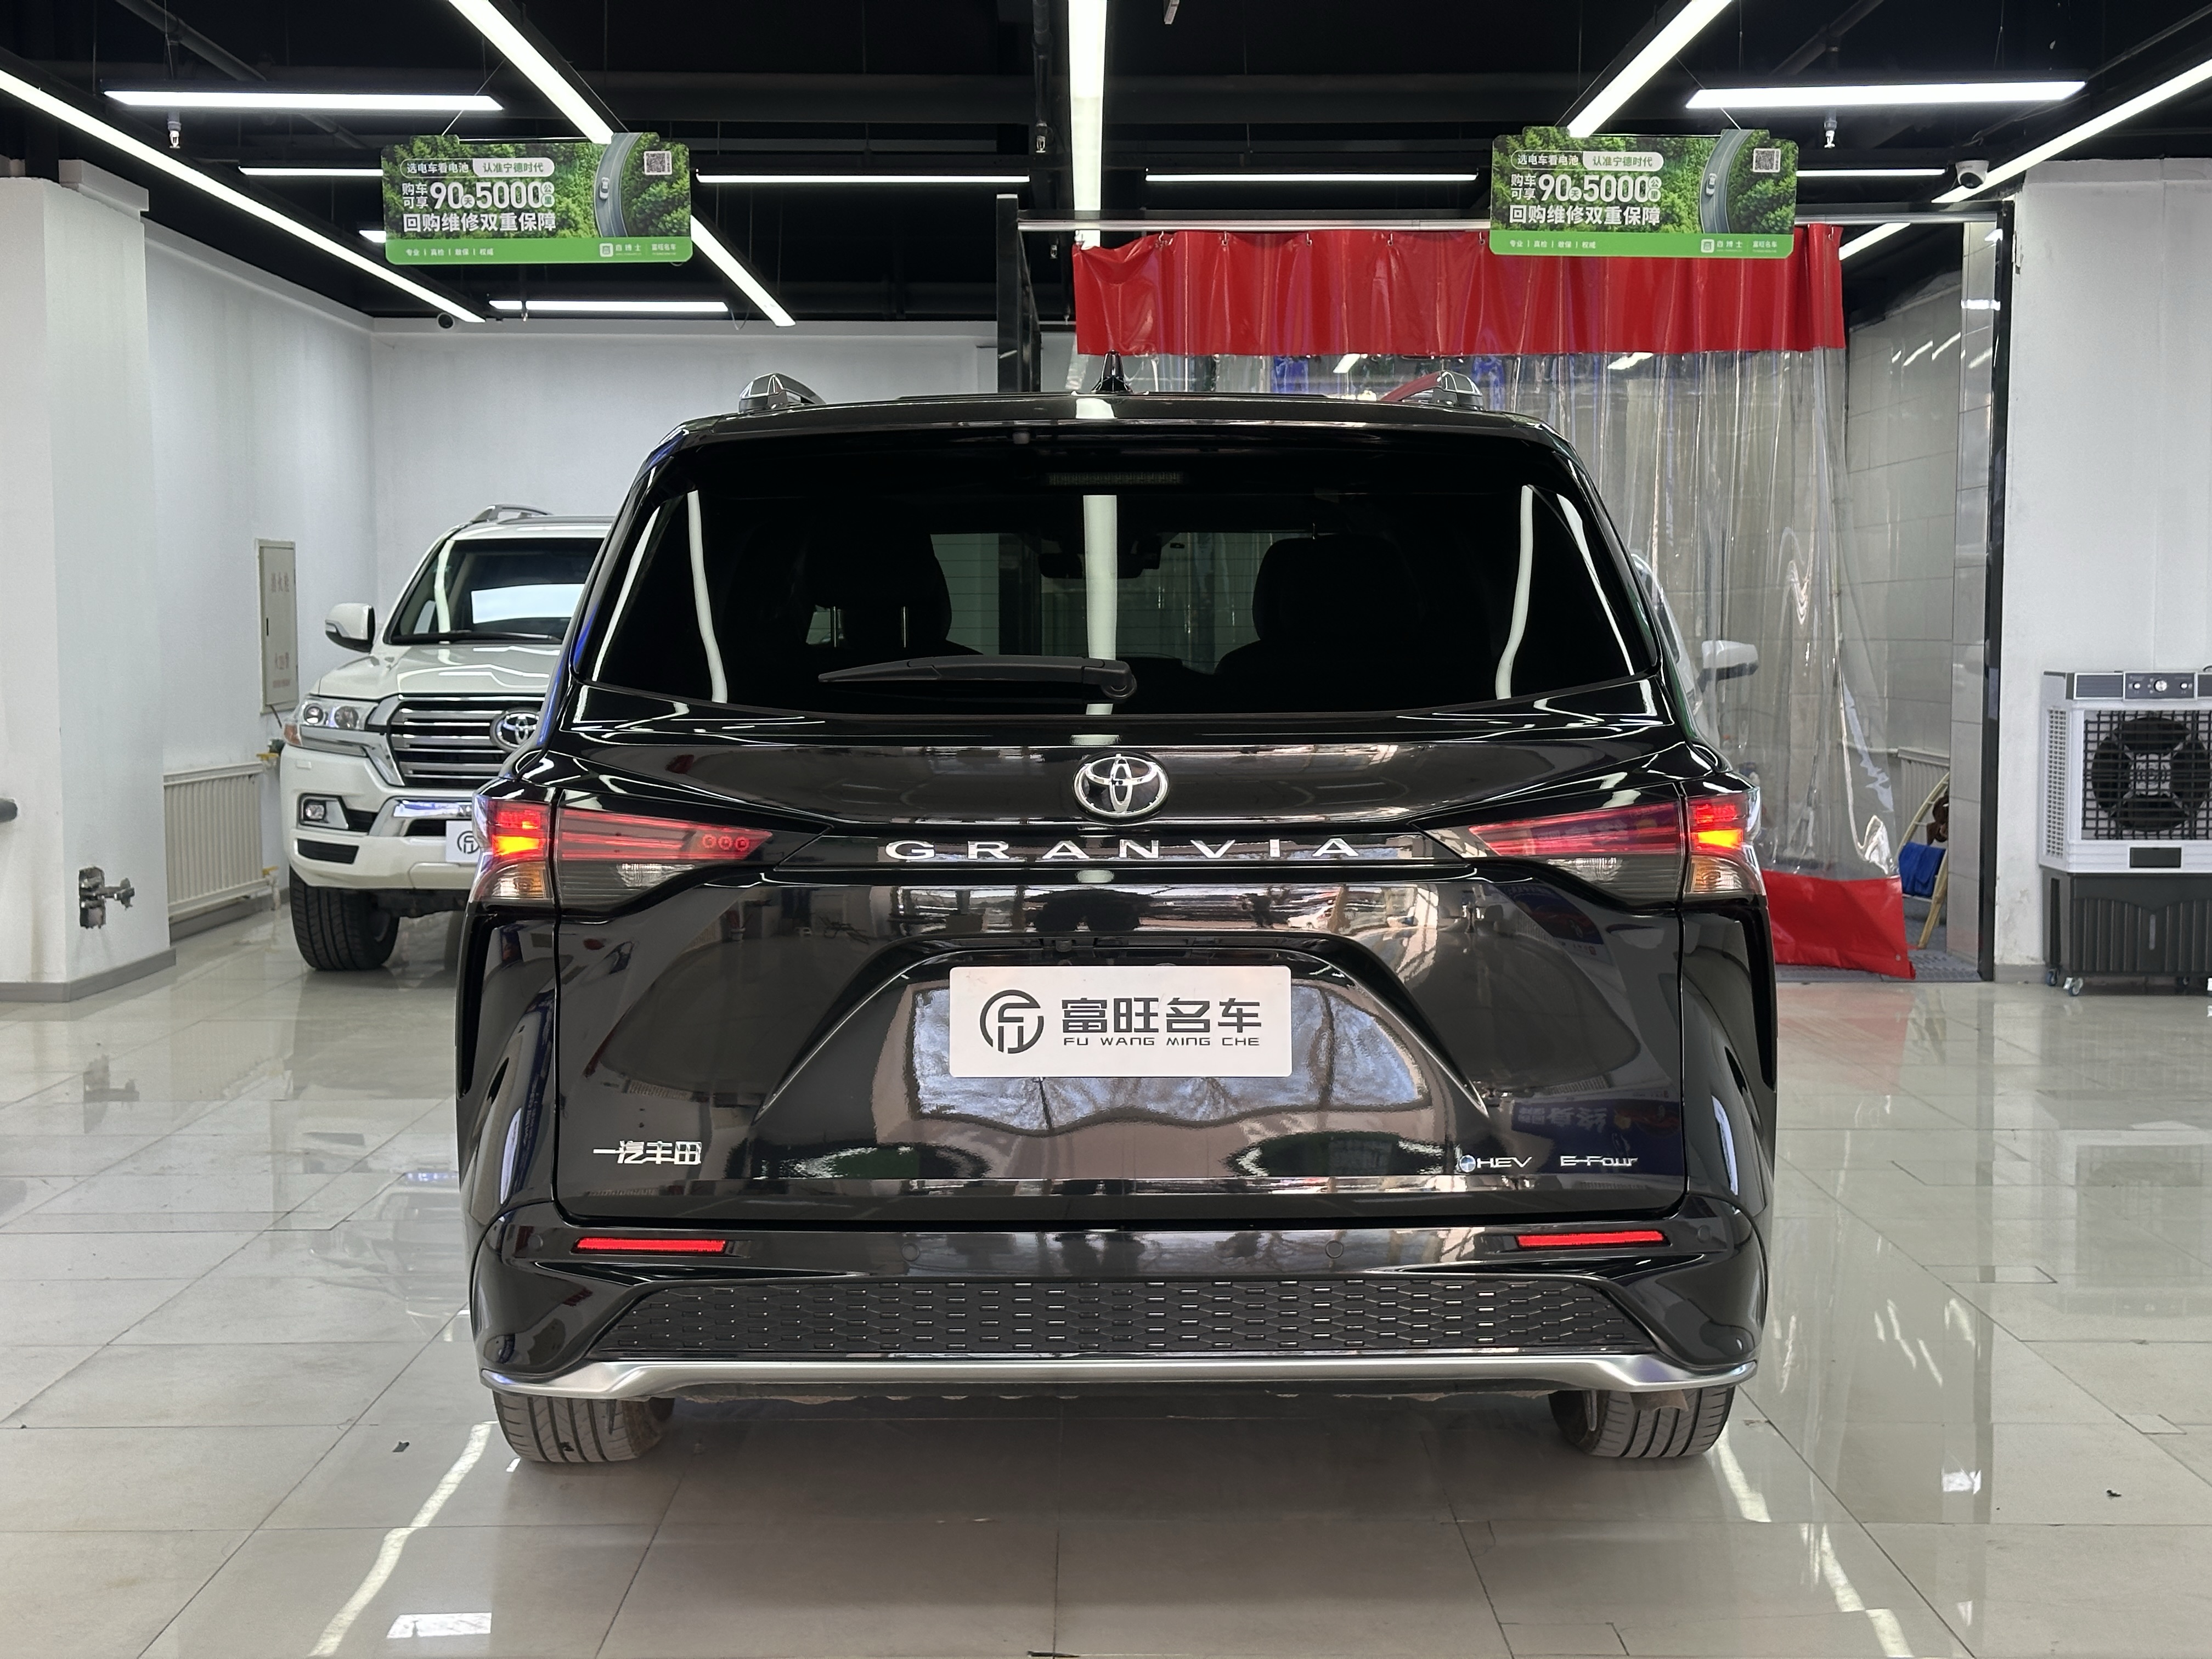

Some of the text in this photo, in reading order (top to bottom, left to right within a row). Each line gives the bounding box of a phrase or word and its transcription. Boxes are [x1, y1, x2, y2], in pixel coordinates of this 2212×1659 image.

[407, 161, 544, 174] 选电车看电池 认准宁德时代
[1517, 154, 1653, 167] 选电车看电池 认准宁德时代
[403, 212, 556, 232] 回购维修双重保障
[1509, 205, 1660, 225] 回购维修双重保障
[885, 838, 1360, 861] GRANVIA
[1062, 997, 1262, 1033] 富旺名车
[1063, 1037, 1260, 1046] FU WANG MING CHE
[592, 1140, 702, 1165] 一汽丰田
[1476, 1156, 1532, 1169] HEV
